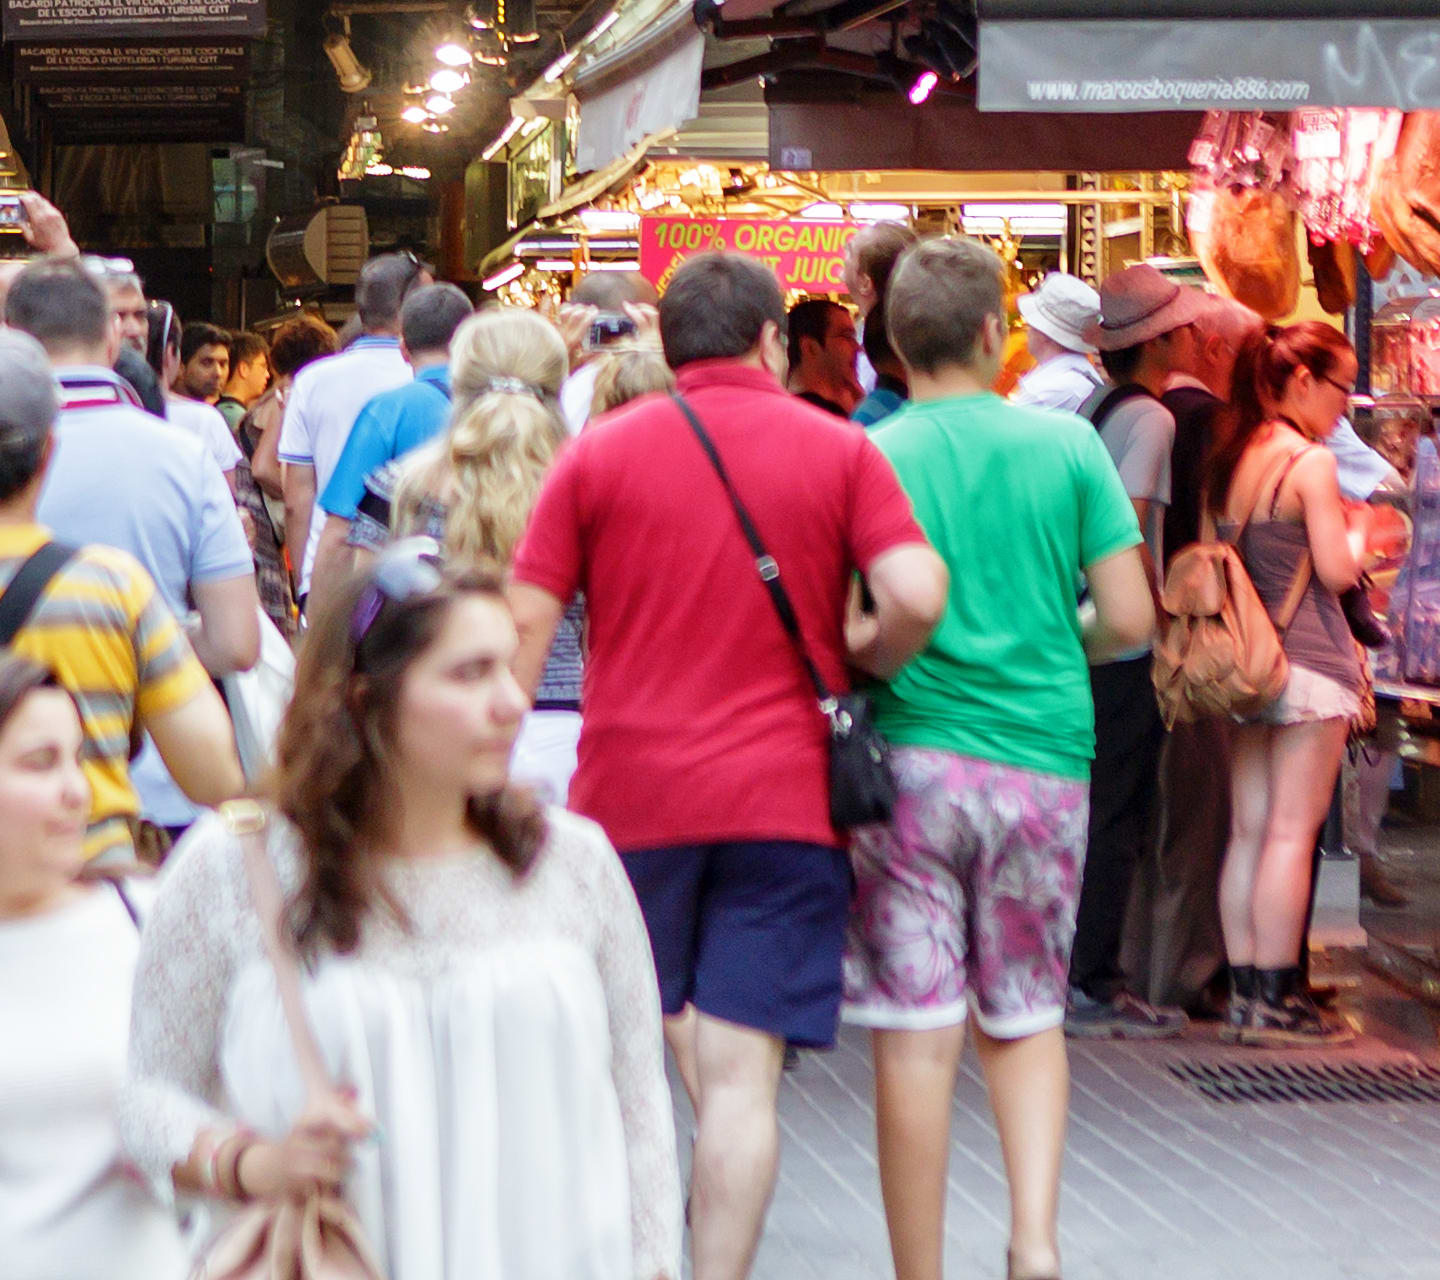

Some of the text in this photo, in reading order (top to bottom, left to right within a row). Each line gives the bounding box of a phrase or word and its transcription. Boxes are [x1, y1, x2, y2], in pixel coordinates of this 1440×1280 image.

[38, 9, 50, 18] DE
[99, 7, 159, 17] D'HOTELERIA
[168, 6, 206, 15] TURISME
[655, 222, 726, 251] 100%
[786, 256, 846, 284] JUIC
